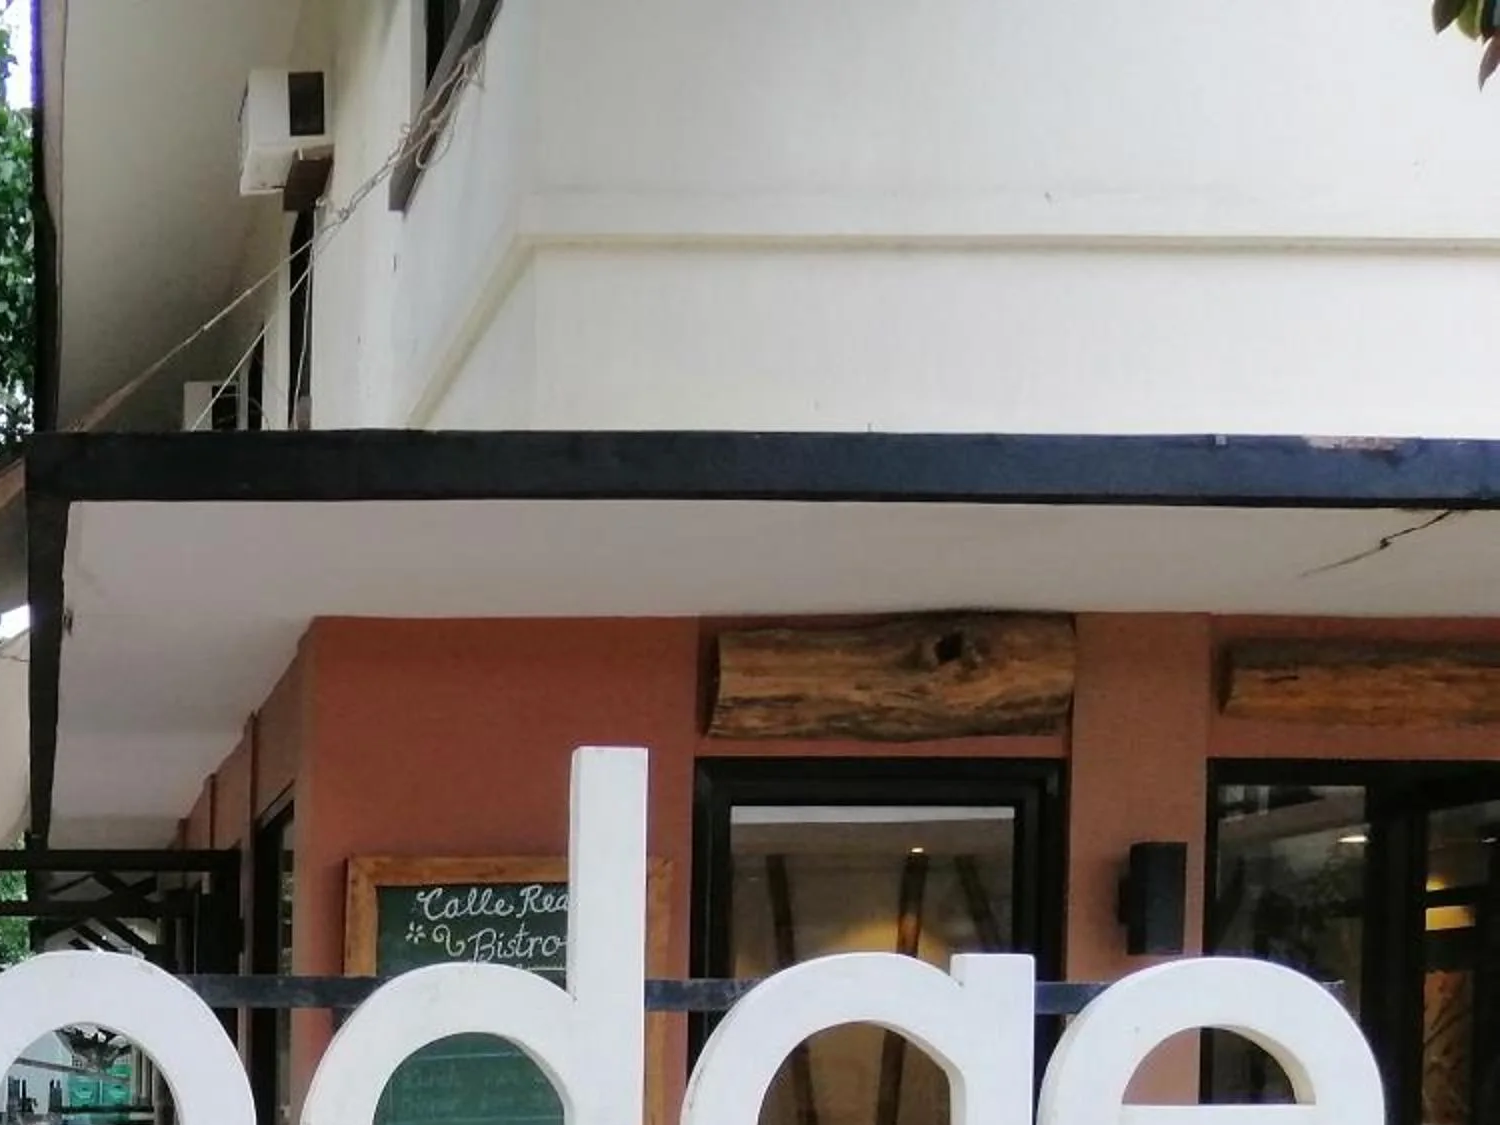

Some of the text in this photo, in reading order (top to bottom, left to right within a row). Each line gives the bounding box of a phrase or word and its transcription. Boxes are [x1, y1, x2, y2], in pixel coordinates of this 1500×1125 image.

[416, 884, 570, 921] Calle Rea
[467, 923, 567, 964] Bistro
